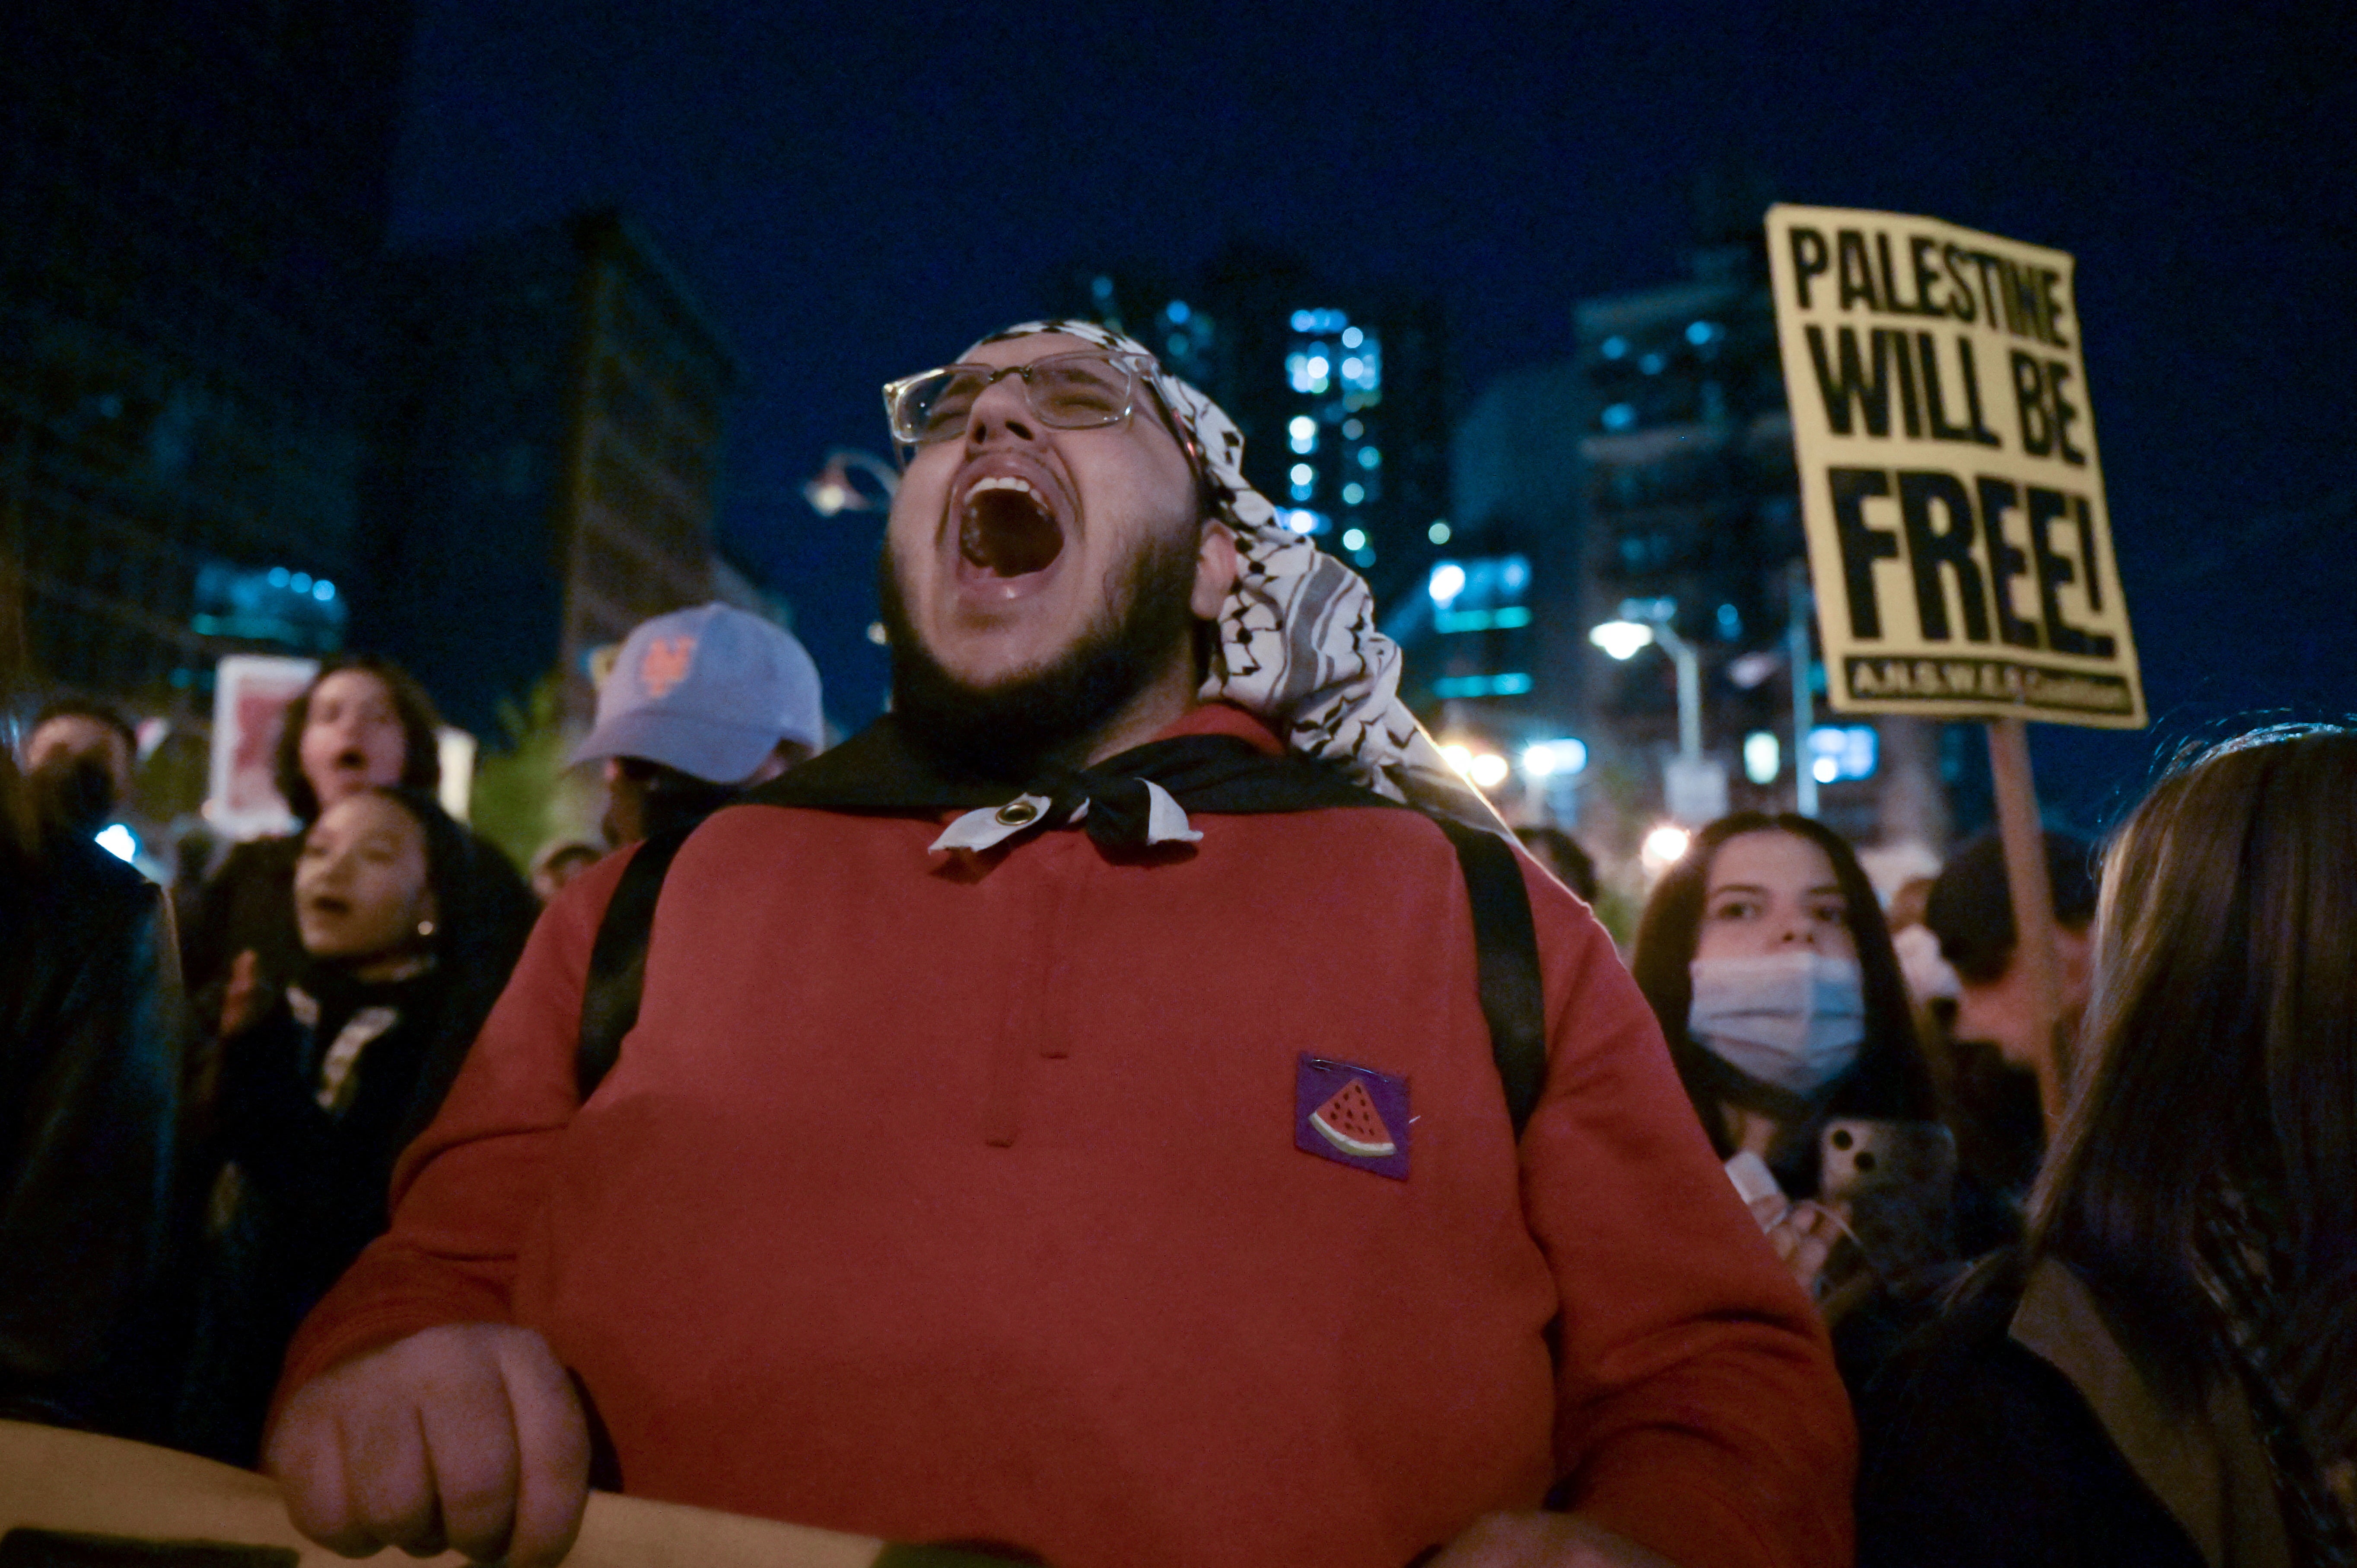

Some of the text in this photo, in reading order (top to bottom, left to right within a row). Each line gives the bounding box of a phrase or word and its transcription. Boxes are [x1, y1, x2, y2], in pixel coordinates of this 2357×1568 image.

[1790, 227, 2068, 348] PALESTINE
[1805, 324, 2086, 467] WILL BE
[1828, 468, 2116, 658] FREE!
